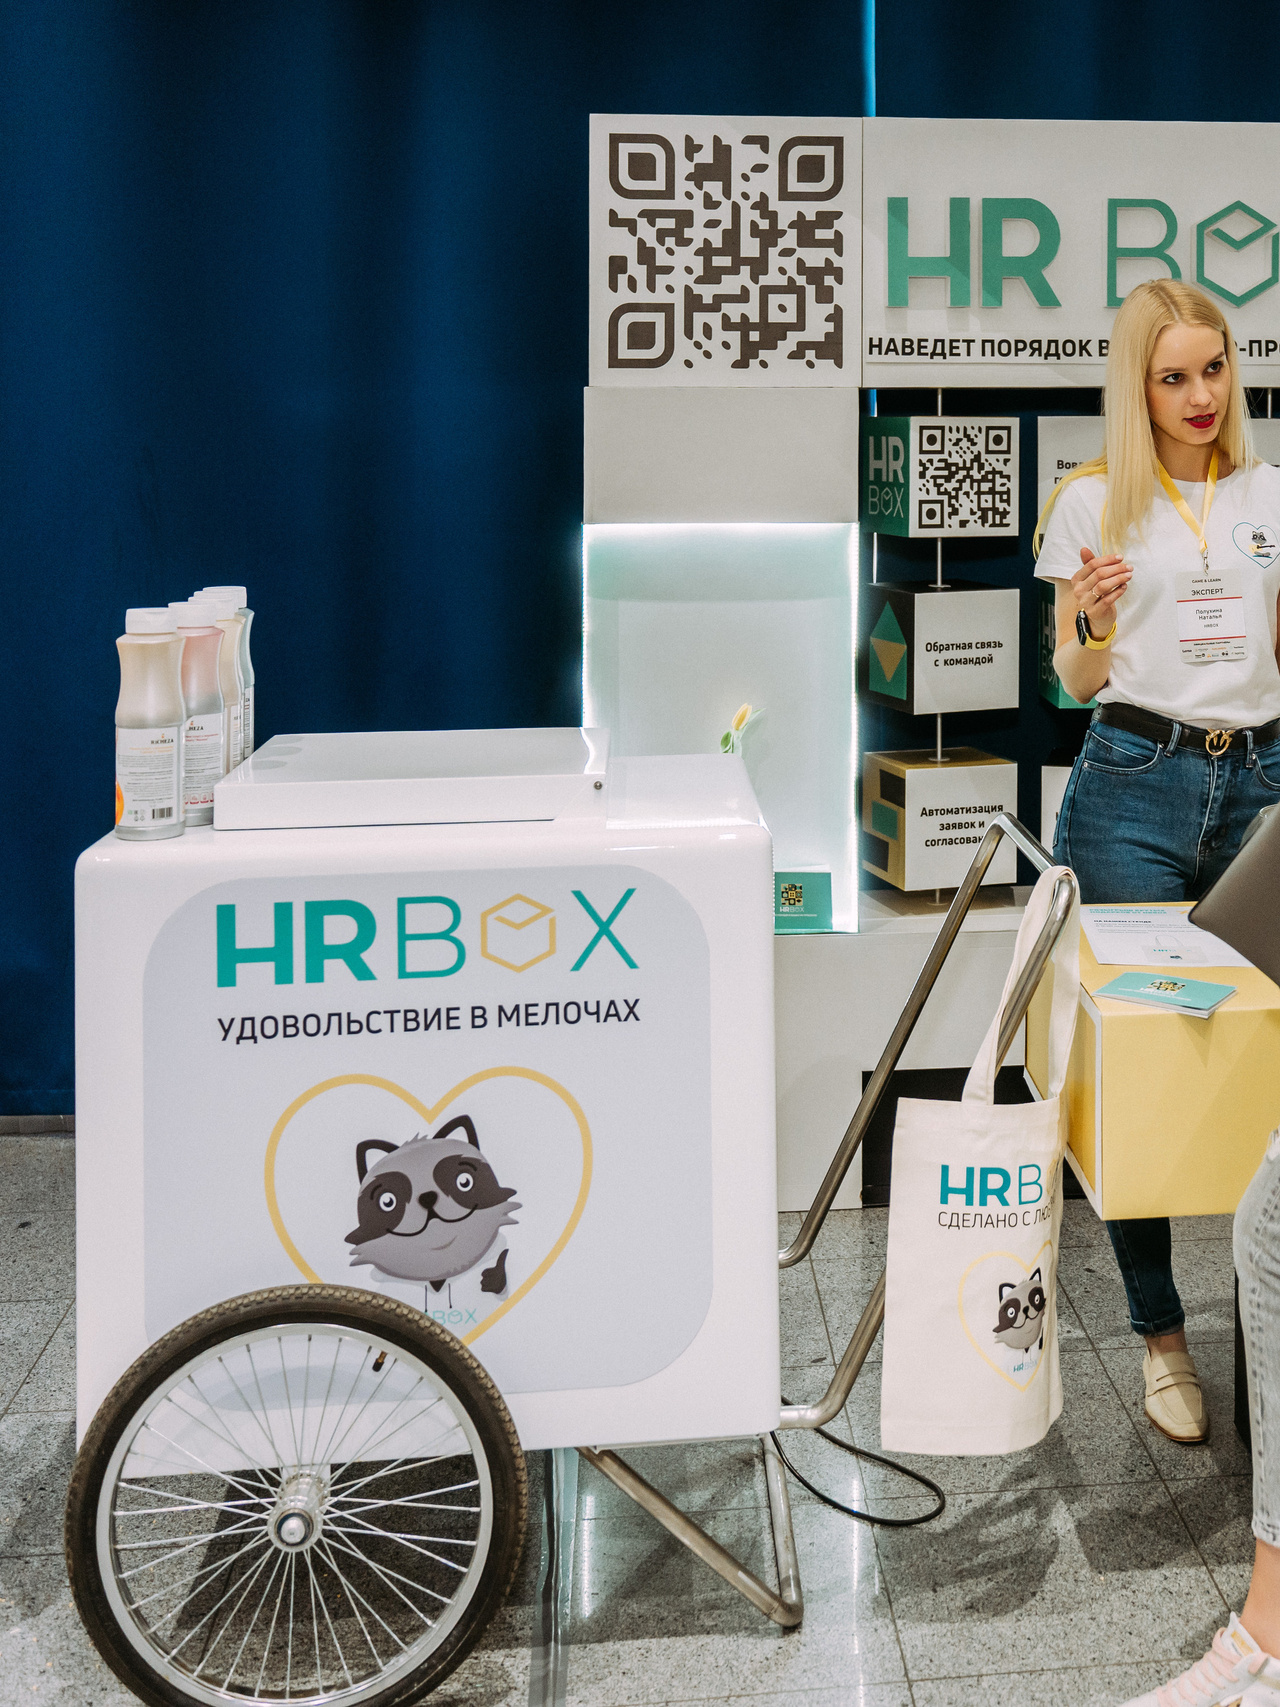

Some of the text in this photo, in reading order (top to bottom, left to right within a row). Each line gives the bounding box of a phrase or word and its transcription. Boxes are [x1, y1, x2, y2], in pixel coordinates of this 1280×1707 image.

[887, 197, 1062, 308] HR
[868, 337, 975, 360] НАВЕДЕТ
[981, 339, 1092, 361] ПОРЯДОК
[868, 435, 905, 483] HR
[868, 485, 904, 518] BOX
[1191, 588, 1224, 596] ЭКСПЕРТ
[925, 640, 1004, 654] Обратная связь
[934, 653, 994, 667] с командой
[920, 804, 1004, 818] Автоматизация
[939, 820, 985, 831] заявок и
[925, 835, 984, 847] согласован
[217, 998, 640, 1045] УДОВОЛЬСТВИЕ В МЕЛОЧАХ
[938, 1211, 1018, 1230] СДЕЛАНО
[1022, 1210, 1031, 1227] С
